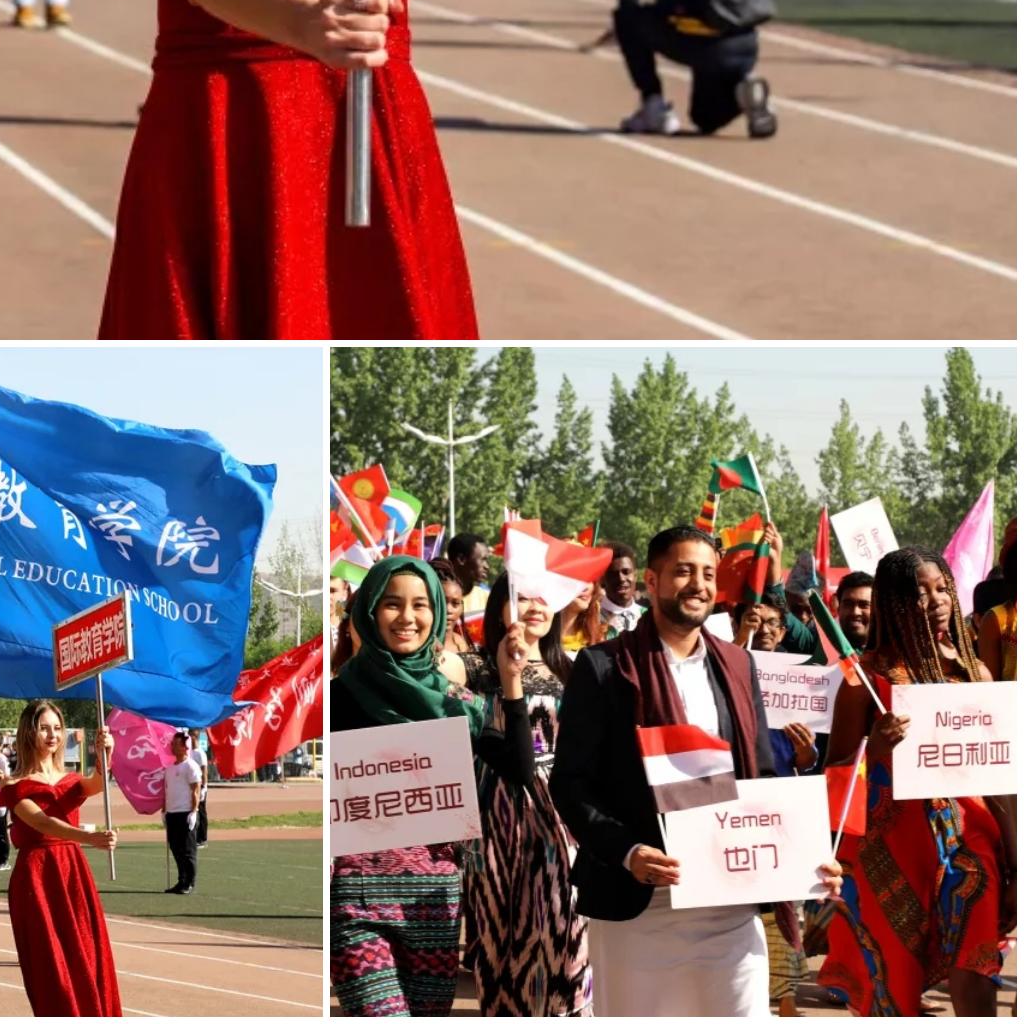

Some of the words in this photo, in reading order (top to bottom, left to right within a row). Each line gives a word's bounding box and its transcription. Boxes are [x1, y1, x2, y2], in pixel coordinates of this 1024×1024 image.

[13, 559, 141, 603] EDUCATION
[143, 588, 219, 624] SCHOOL
[59, 612, 125, 674] 国际教育学院
[935, 710, 993, 730] Nigeria
[334, 752, 433, 781] Indonesia
[917, 740, 1011, 769] 尼日利亚
[714, 811, 782, 830] Yemen
[723, 843, 779, 873] 也门
